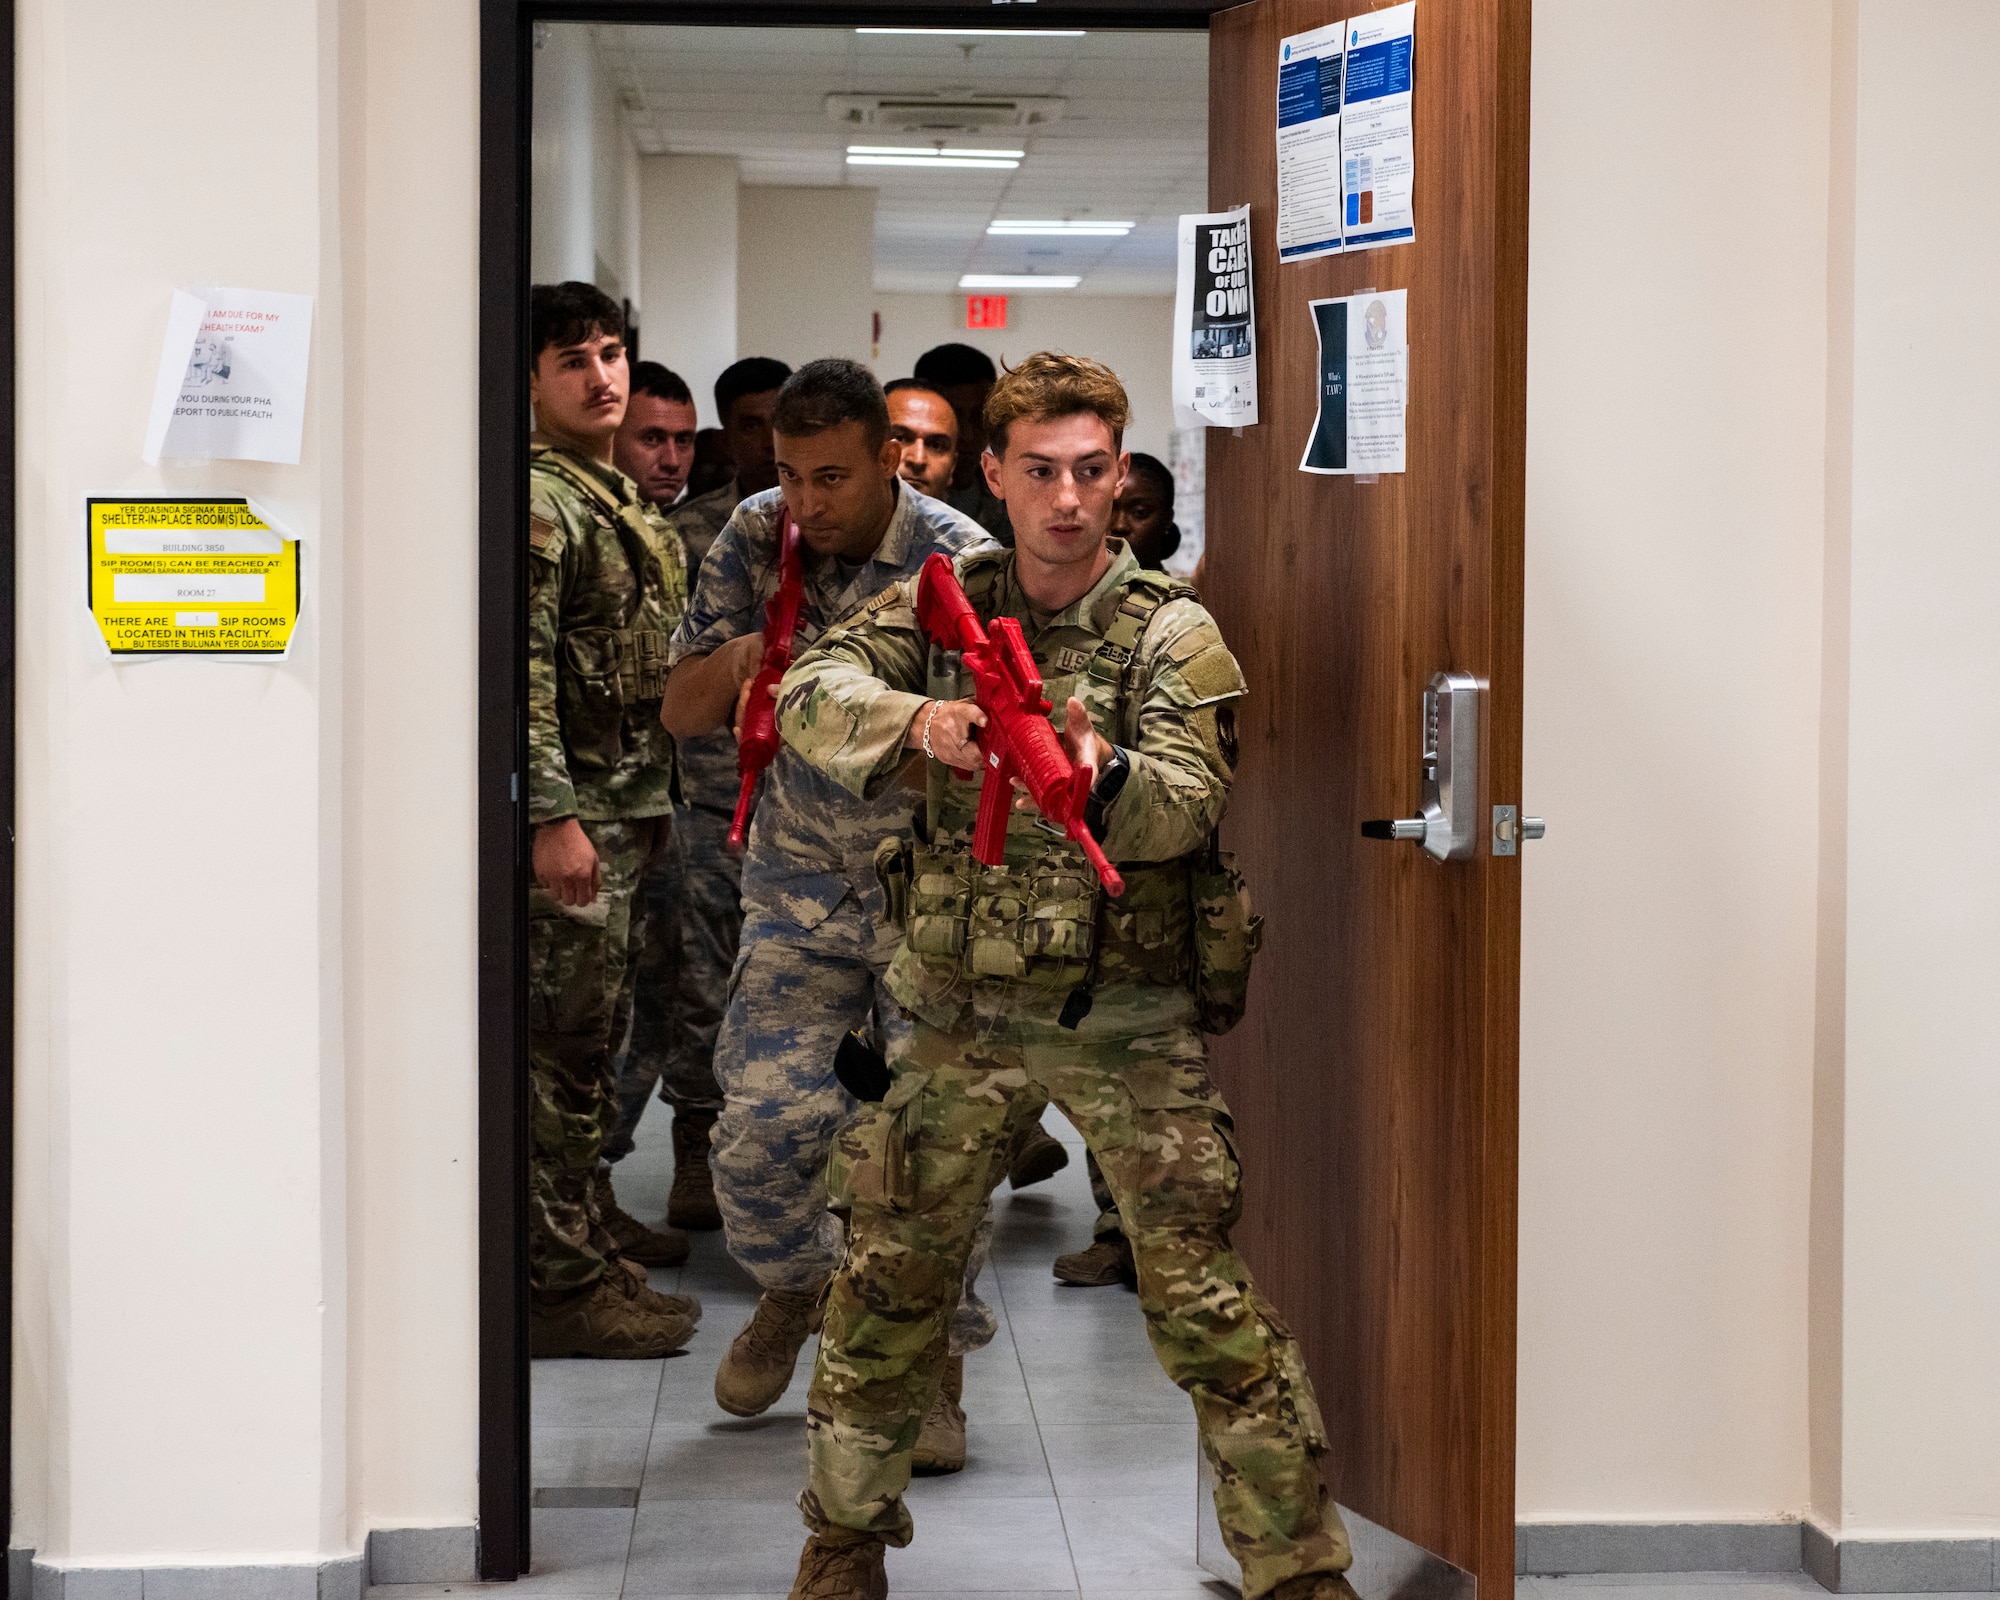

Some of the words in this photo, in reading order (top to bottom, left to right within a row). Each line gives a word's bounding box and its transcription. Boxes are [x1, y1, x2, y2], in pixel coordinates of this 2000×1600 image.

[1208, 243, 1247, 273] CARE
[1215, 276, 1230, 288] OF
[1206, 286, 1248, 317] OWN
[213, 310, 227, 318] AM
[228, 311, 244, 319] DUE
[246, 311, 263, 320] FOR
[265, 312, 280, 321] MY
[204, 323, 233, 332] HEALTH
[235, 324, 265, 333] EXAM?
[180, 394, 199, 403] YOU
[201, 395, 230, 404] DURING
[231, 395, 252, 404] YOUR
[253, 397, 272, 406] PHA
[205, 408, 217, 417] TO
[218, 408, 239, 417] PUBLIC
[240, 409, 273, 419] HEALTH
[120, 506, 136, 514] YER
[138, 506, 180, 514] ODASINDA
[101, 513, 192, 525] SHELTER-IN-PLACE
[196, 513, 238, 527] ROOM(S)
[162, 544, 203, 552] BUILDING
[204, 544, 225, 552] 3850
[120, 560, 167, 568] ROOM(S)
[177, 589, 205, 597] ROOM
[206, 589, 216, 597] 27
[103, 617, 141, 626] THERE
[145, 617, 169, 626] ARE
[221, 617, 239, 626] SIP
[242, 617, 286, 626] ROOMS
[117, 629, 172, 638] LOCATED
[175, 630, 186, 638] IN
[190, 629, 216, 638] THIS
[219, 629, 273, 638] FACILITY.
[133, 640, 145, 648] BU
[147, 640, 180, 648] TESISTE
[182, 640, 221, 648] BULUNAN
[223, 640, 240, 648] YER
[242, 640, 259, 648] ODA
